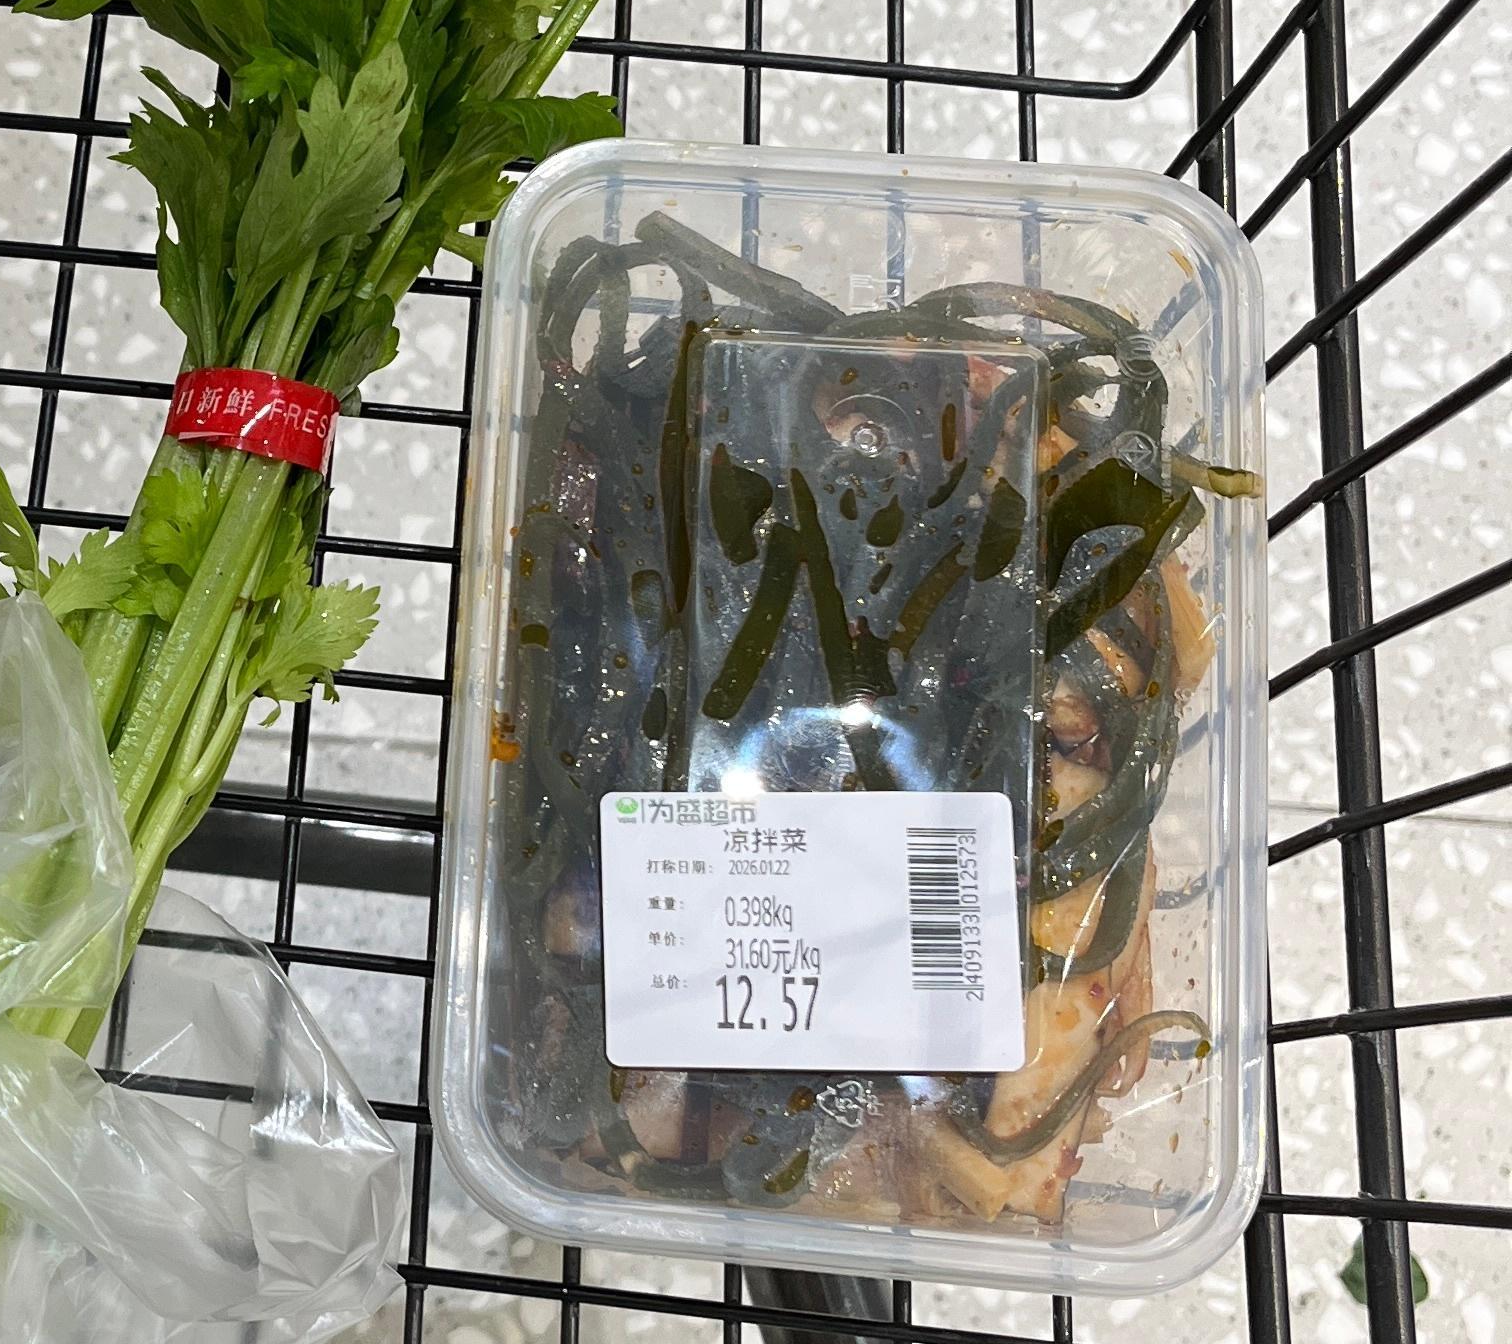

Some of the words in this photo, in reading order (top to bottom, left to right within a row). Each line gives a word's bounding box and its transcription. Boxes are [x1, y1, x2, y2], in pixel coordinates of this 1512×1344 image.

[648, 798, 757, 826] 为盛超市
[723, 827, 808, 853] 凉拌菜
[728, 859, 791, 876] 2026.01.22
[724, 895, 794, 933] 0.398kg
[958, 834, 985, 1002] 2409133012573
[725, 938, 822, 975] 31.60元/kg
